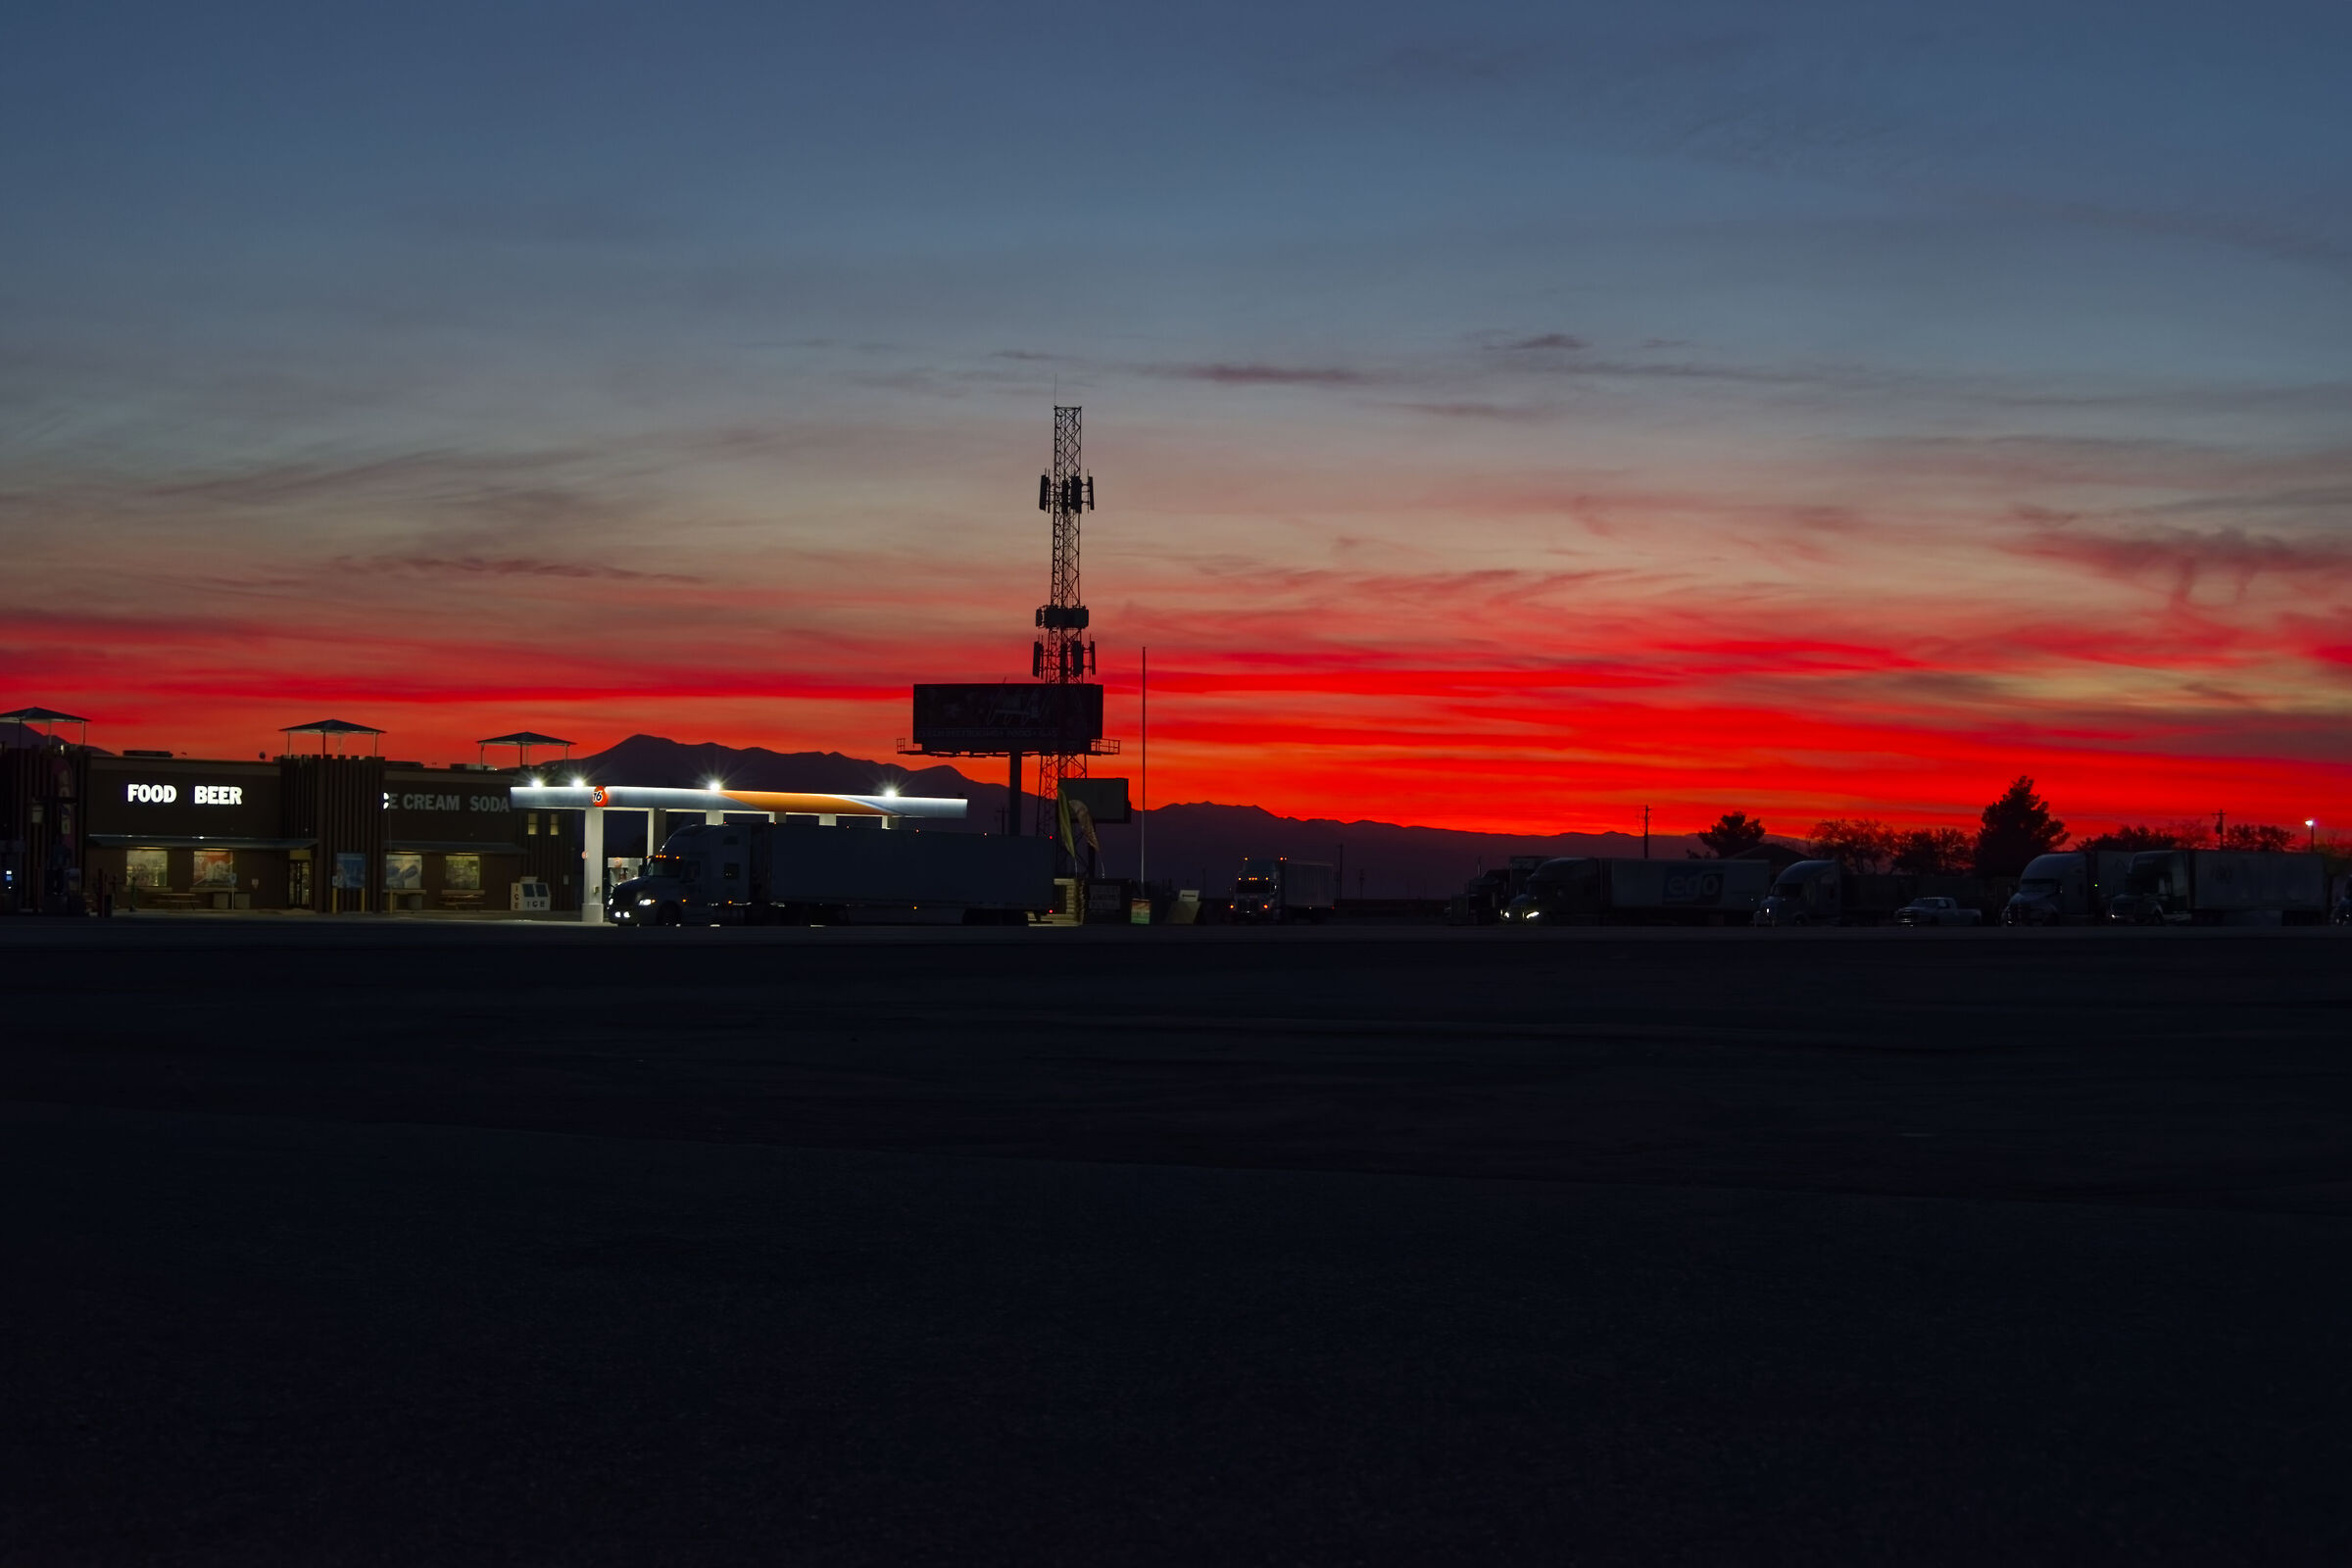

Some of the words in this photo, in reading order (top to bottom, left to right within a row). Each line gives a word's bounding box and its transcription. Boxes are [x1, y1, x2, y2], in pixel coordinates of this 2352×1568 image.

[127, 784, 177, 804] FOOD
[194, 785, 243, 805] BEER
[403, 793, 462, 811] CREAM
[469, 795, 512, 813] SODA
[592, 790, 604, 803] 76
